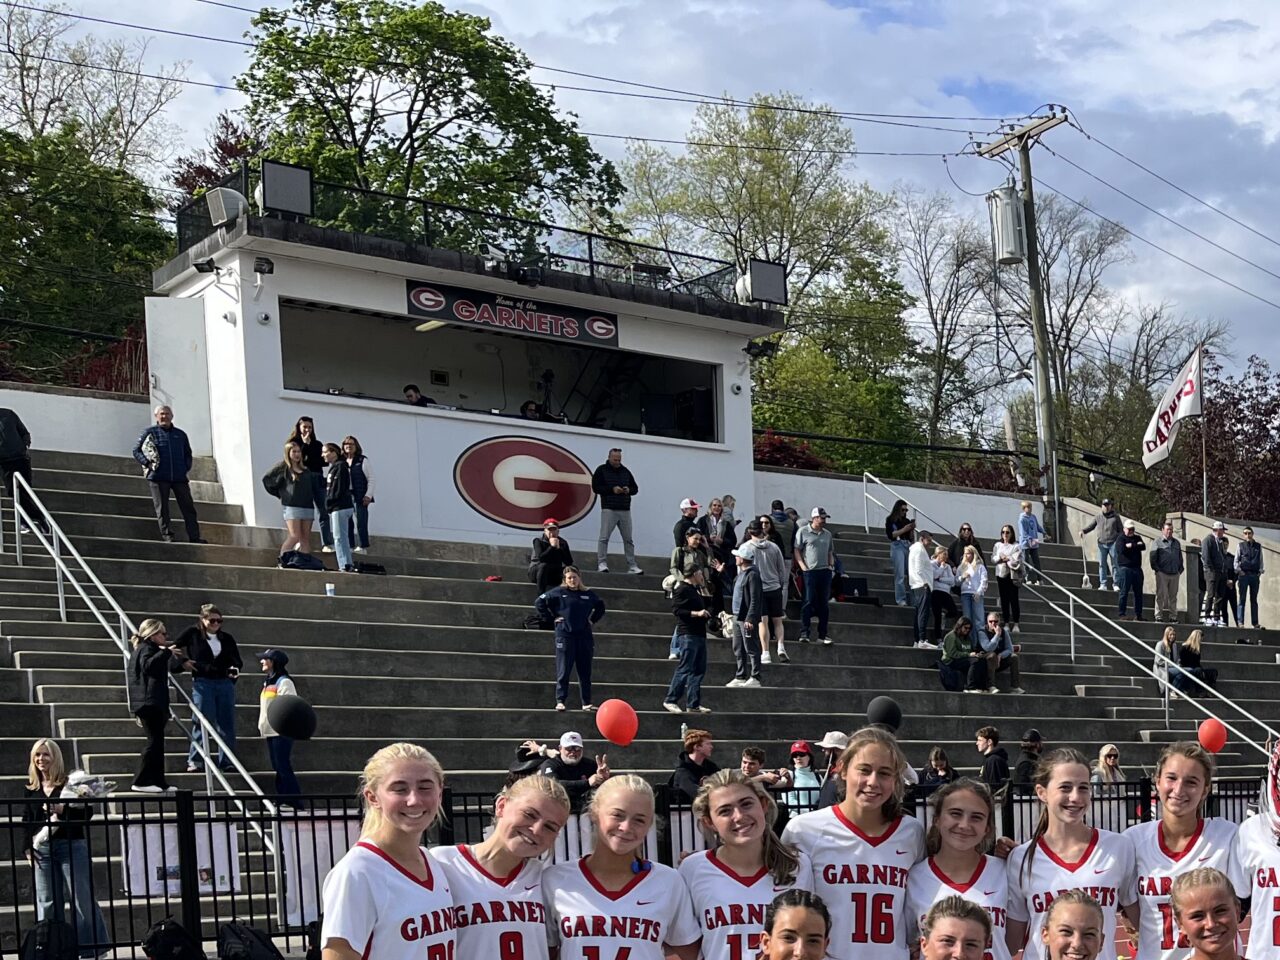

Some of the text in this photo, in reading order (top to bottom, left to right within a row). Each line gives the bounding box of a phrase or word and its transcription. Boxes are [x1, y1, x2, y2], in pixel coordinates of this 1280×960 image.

[452, 300, 579, 338] GARNETS
[495, 296, 537, 310] Home of the
[455, 436, 596, 530] G
[560, 915, 661, 943] GARNETS
[851, 892, 895, 944] 16
